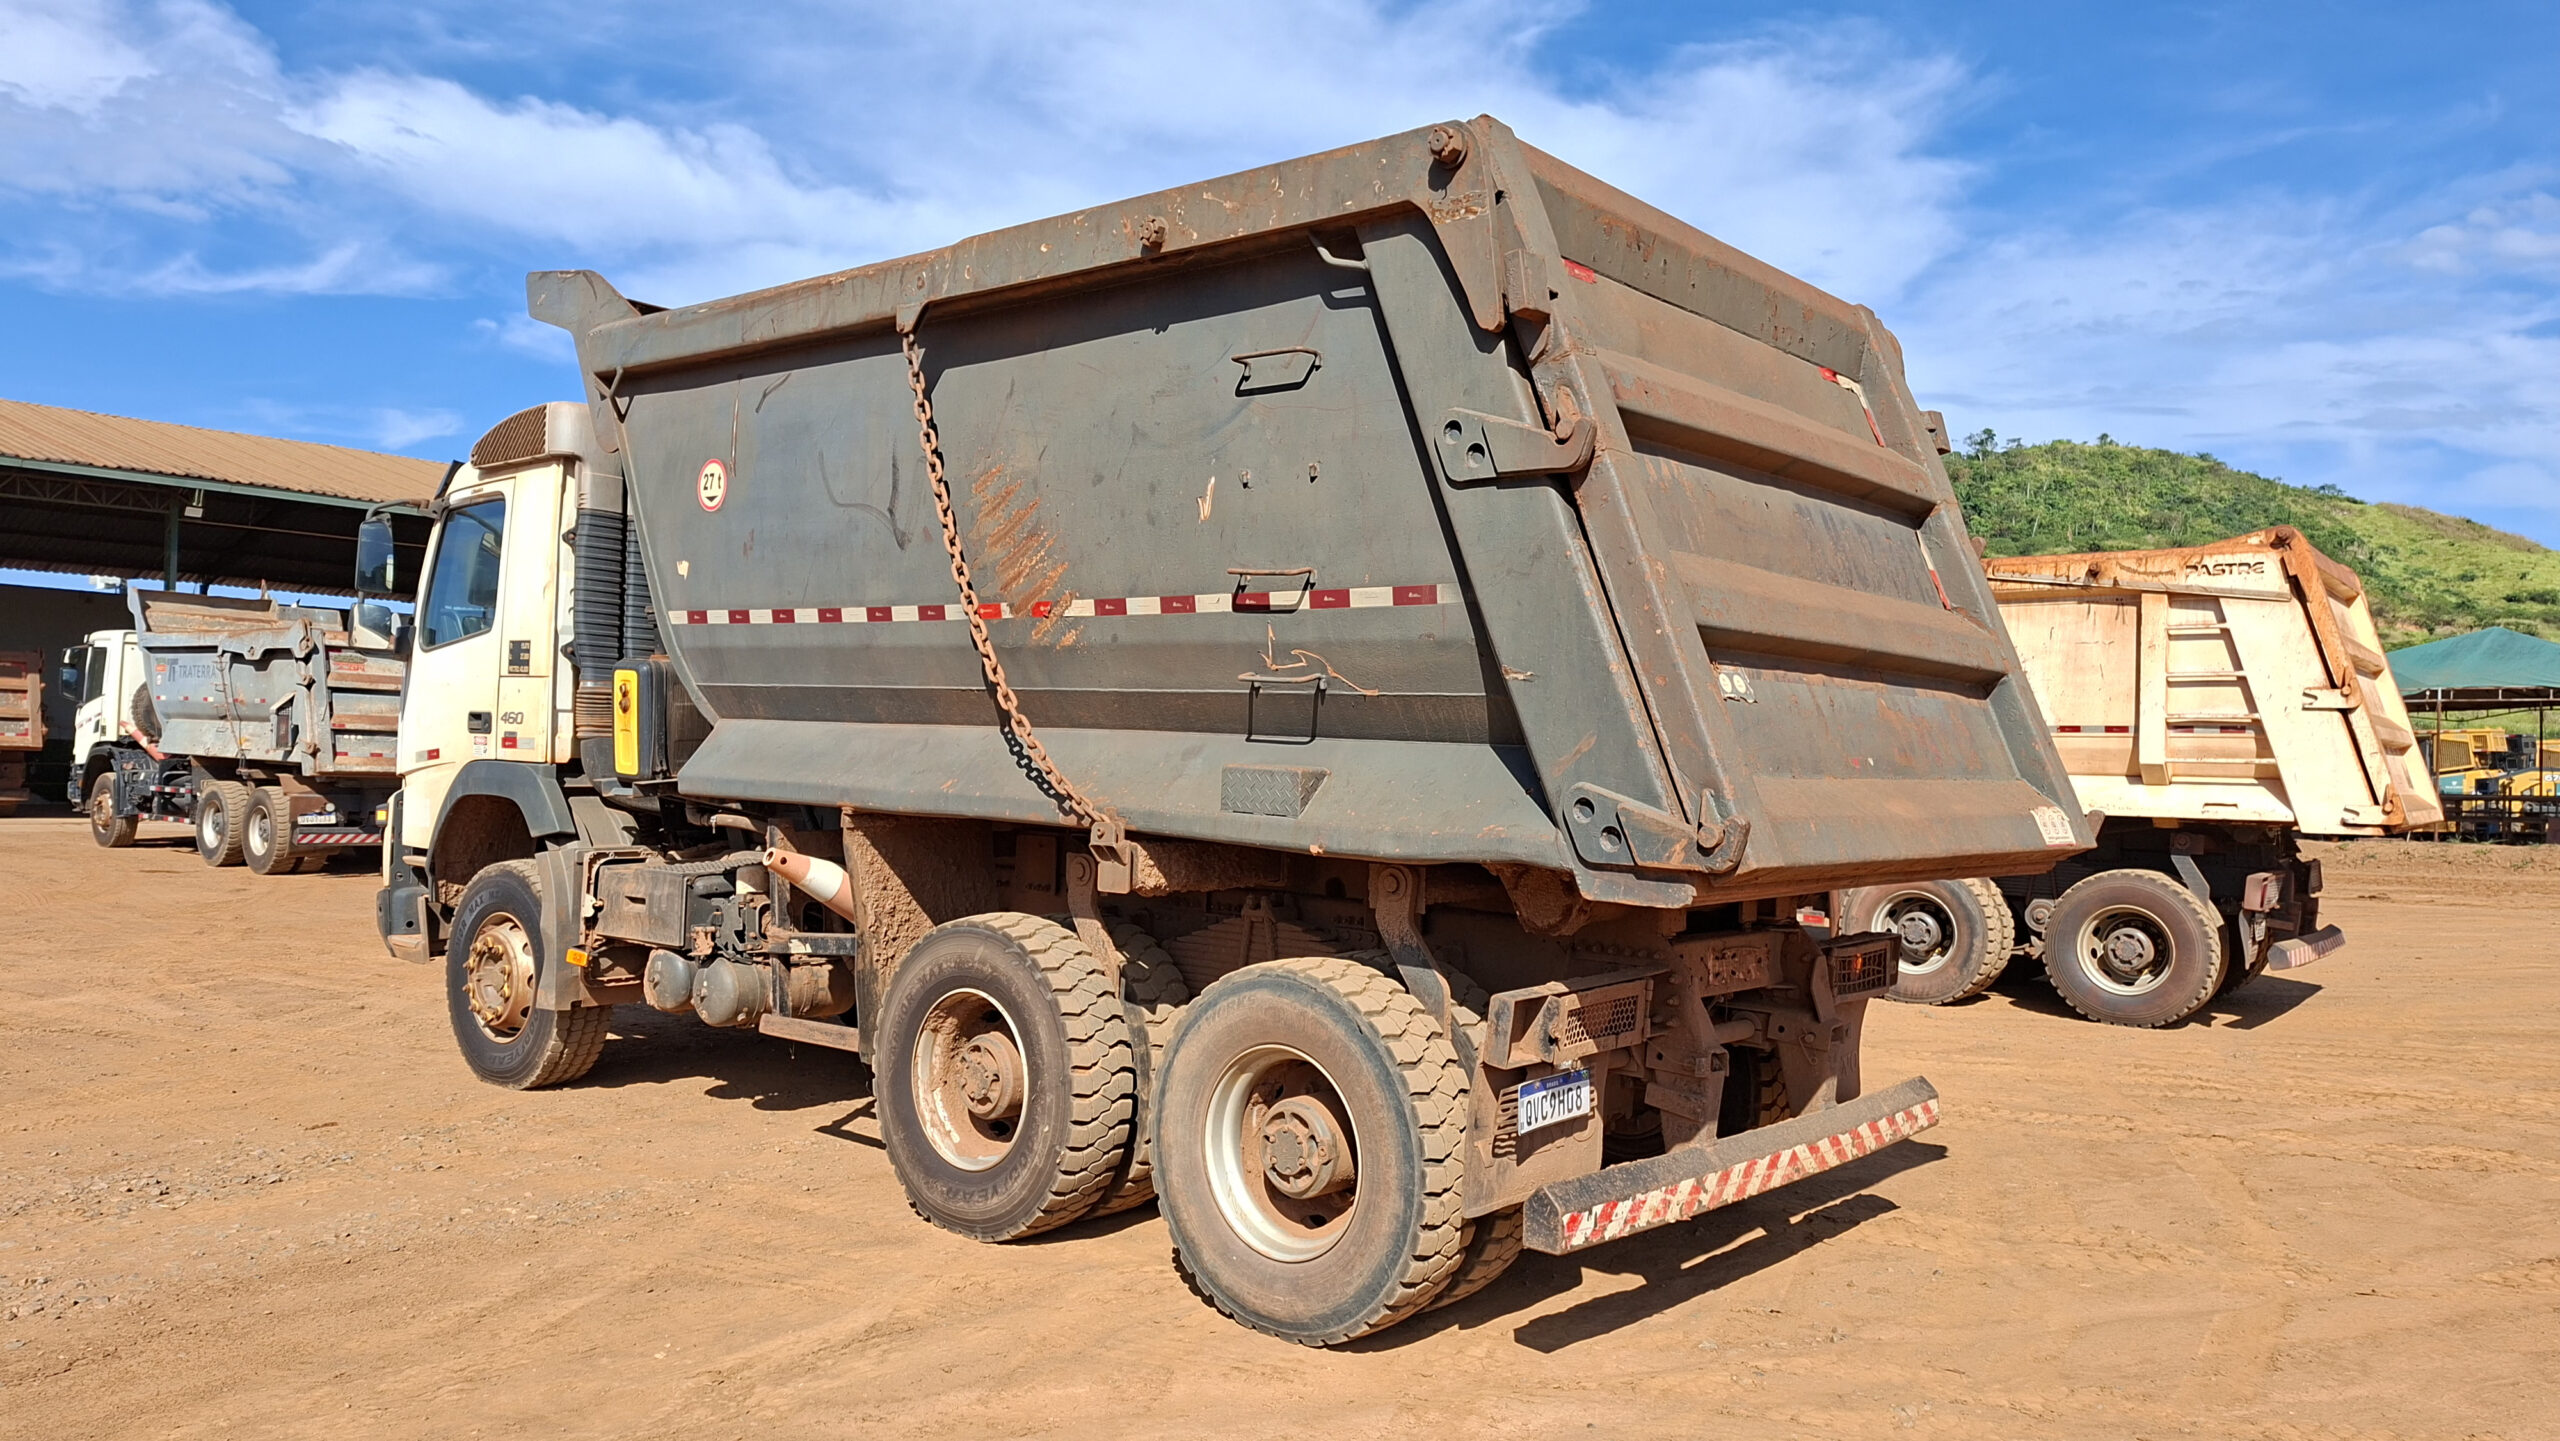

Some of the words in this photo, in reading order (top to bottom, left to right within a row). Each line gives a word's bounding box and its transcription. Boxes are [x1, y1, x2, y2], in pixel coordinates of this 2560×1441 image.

[703, 472, 715, 490] 27
[2185, 561, 2265, 577] PASTRE
[179, 664, 217, 679] TRATERRA
[500, 711, 524, 724] 460
